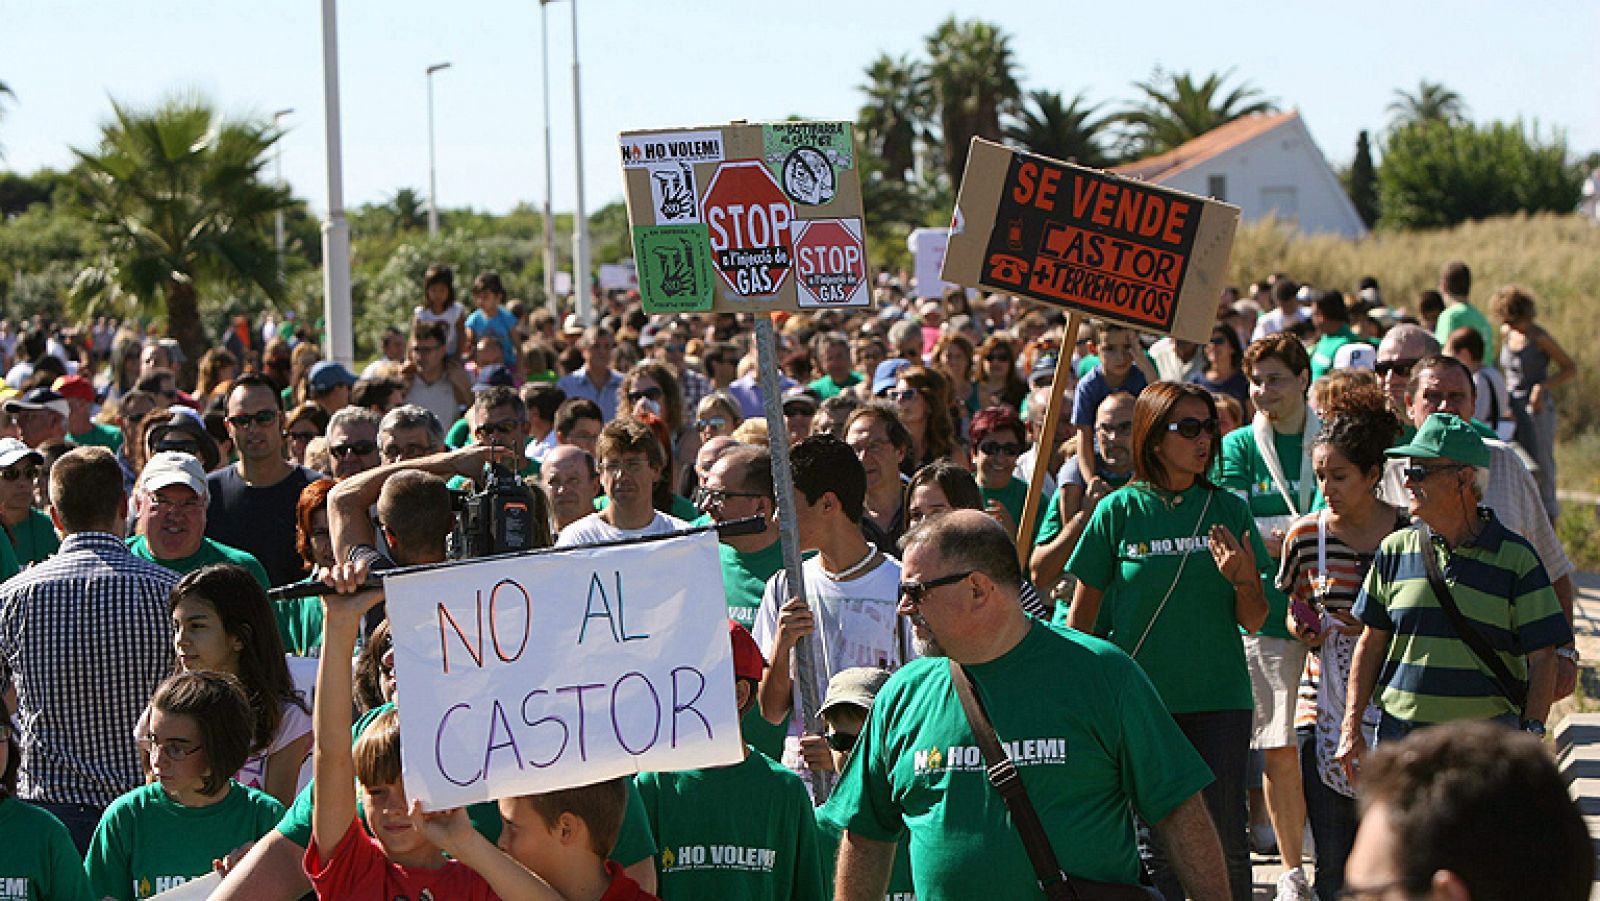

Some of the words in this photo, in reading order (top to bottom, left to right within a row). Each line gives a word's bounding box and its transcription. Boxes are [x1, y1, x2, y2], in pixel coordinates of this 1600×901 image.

[645, 143, 666, 159] HO
[668, 140, 720, 157] VOLEM!
[1012, 162, 1062, 211] SE
[1072, 175, 1190, 245] VENDE
[708, 203, 790, 251] STOP
[801, 246, 859, 275] STOP
[1041, 221, 1175, 286] CASTOR
[736, 265, 772, 295] GAS
[820, 284, 845, 302] GAS
[437, 578, 532, 675] NO
[578, 570, 651, 645] AL
[435, 666, 714, 787] CASTOR
[947, 746, 980, 767] HO
[1001, 738, 1066, 761] LEM!
[678, 846, 705, 865] HO
